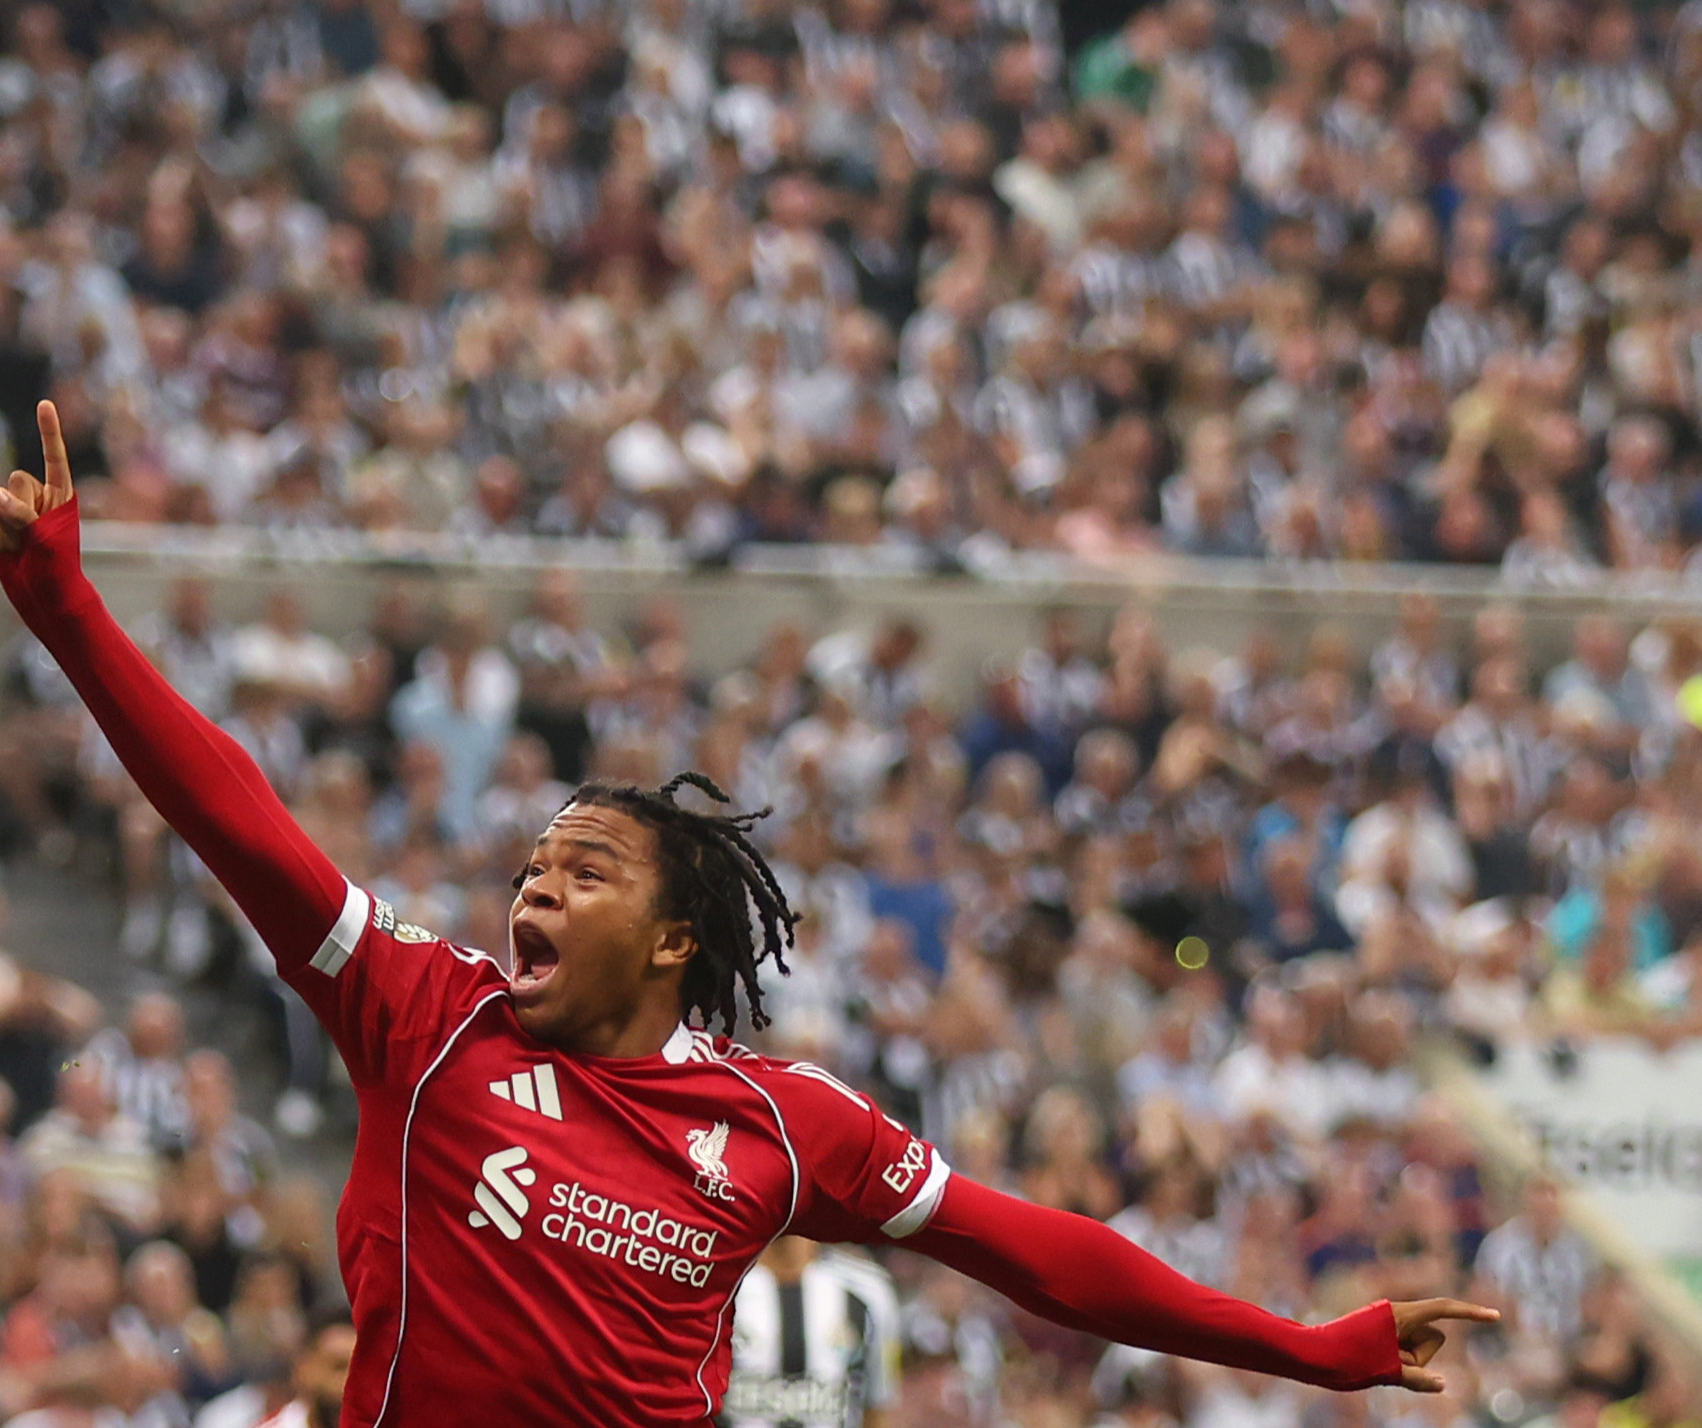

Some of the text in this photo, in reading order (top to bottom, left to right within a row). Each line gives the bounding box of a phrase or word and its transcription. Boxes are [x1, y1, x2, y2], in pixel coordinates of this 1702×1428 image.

[693, 1174, 736, 1202] L.F.C.
[881, 1141, 926, 1194] Exp
[541, 1212, 715, 1288] chartered
[549, 1182, 718, 1258] standard
